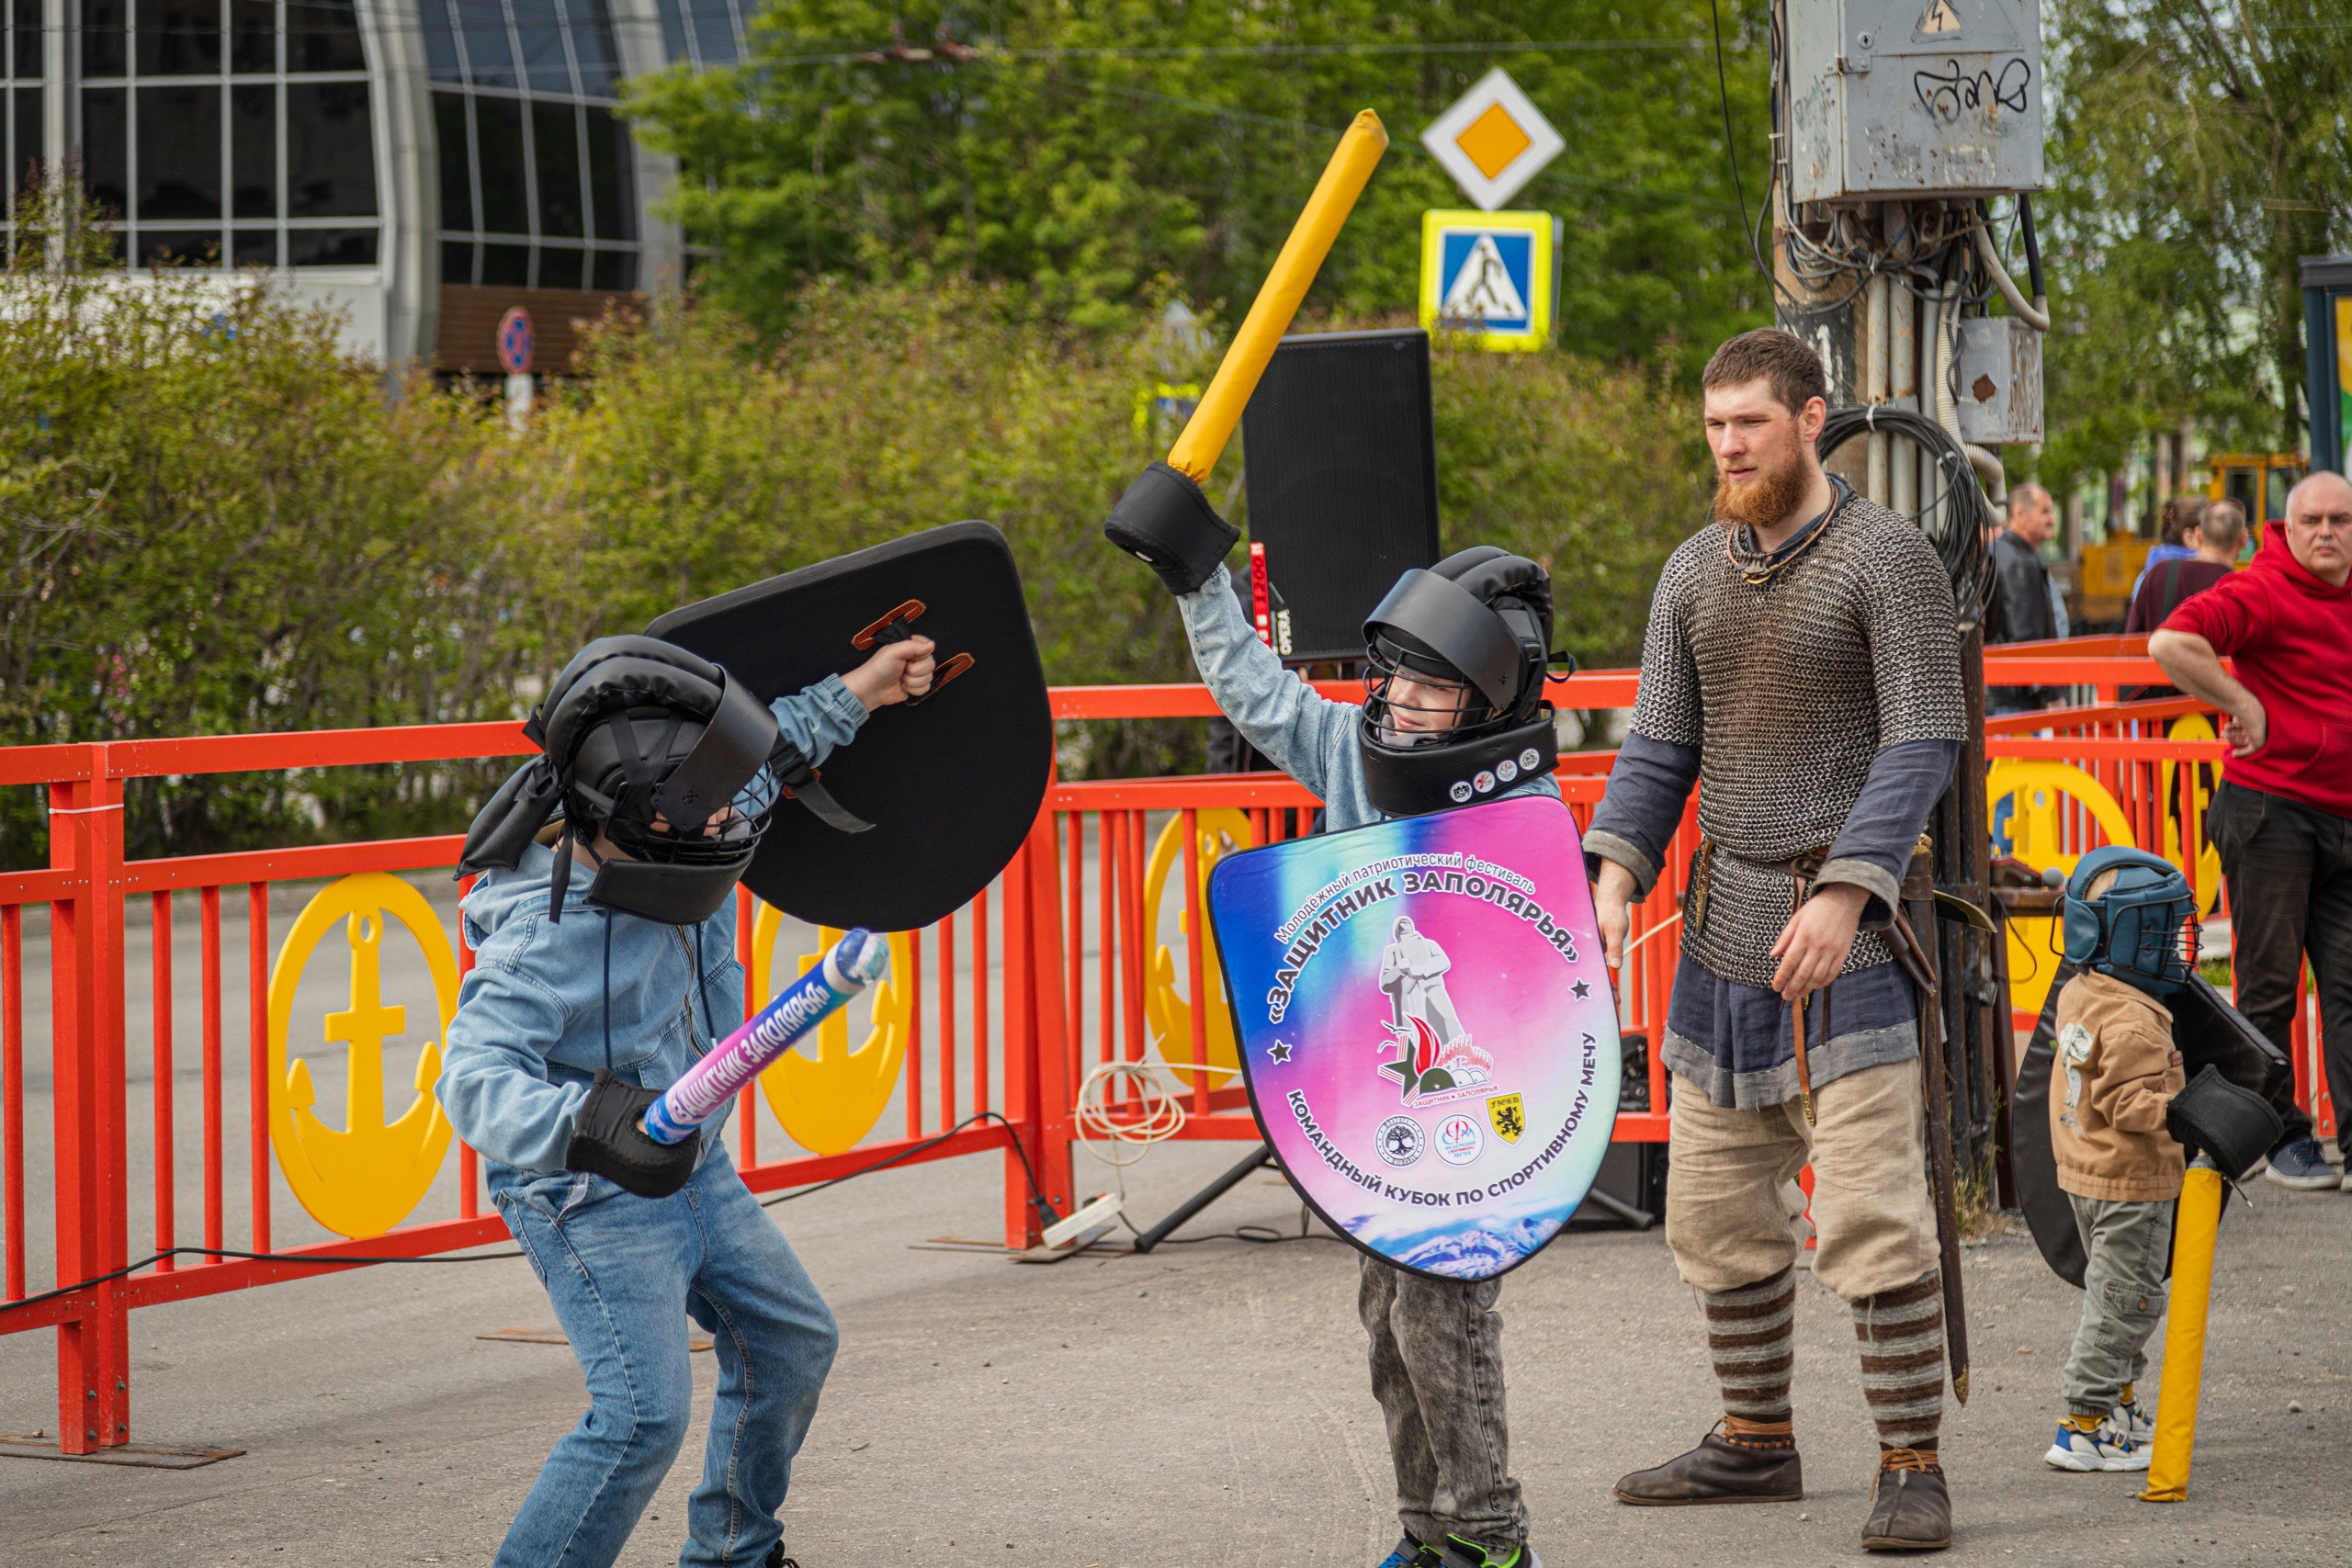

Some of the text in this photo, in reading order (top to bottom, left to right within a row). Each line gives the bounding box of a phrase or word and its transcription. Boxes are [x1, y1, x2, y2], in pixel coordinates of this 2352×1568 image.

[1277, 609, 1292, 656] OPERA
[1277, 853, 1535, 942] Молодёжный патриотический фестиваль
[1269, 873, 1578, 1022] «ЗАЩИТНИК ЗАПОЛЯРЬЯ»
[741, 982, 831, 1063] ЗАПОЛЯРЬЯ»
[1288, 1032, 1596, 1206] КОМАНДНЫЙ КУБОК ПО СПОРТИВНОМУ МЕЧУ
[1414, 1086, 1498, 1107] ЗАЩИТНИК ЗАПОЛЯРЬЯ
